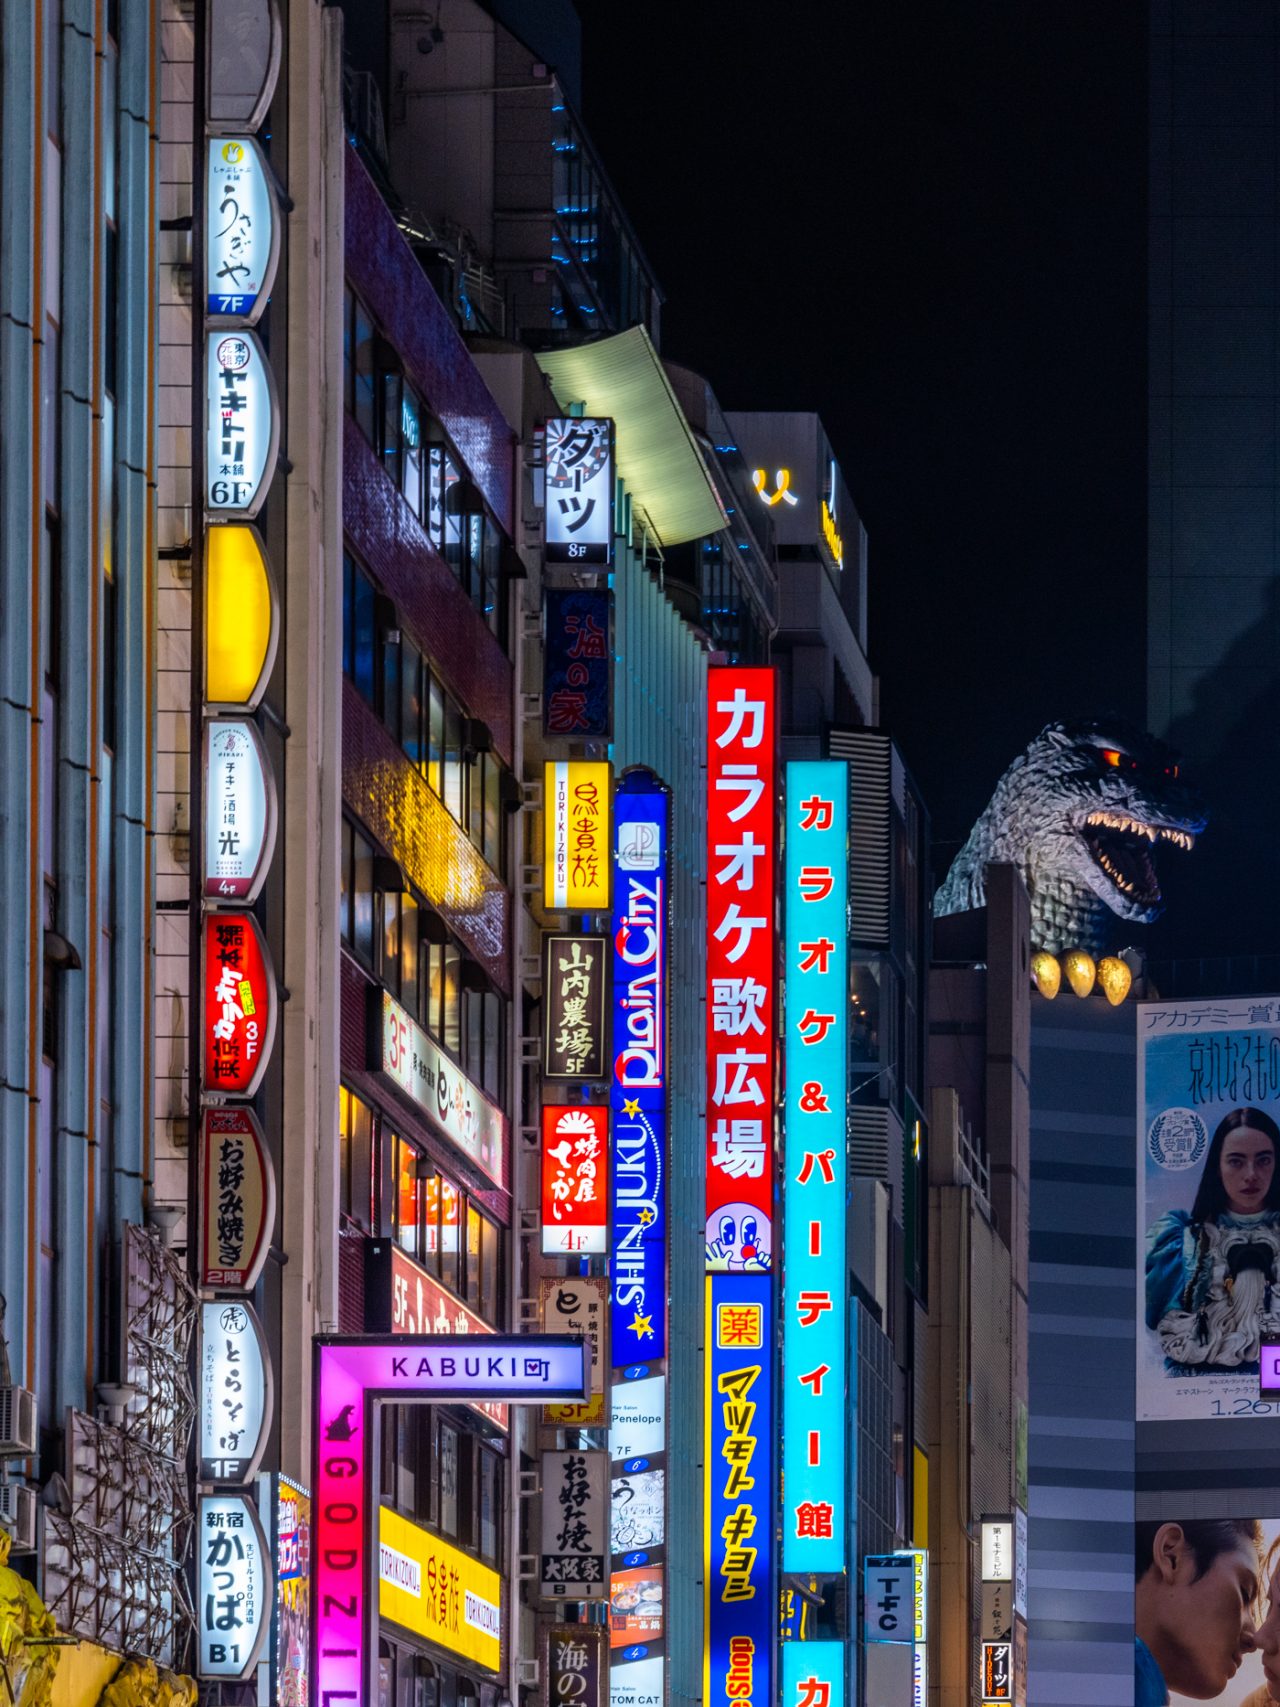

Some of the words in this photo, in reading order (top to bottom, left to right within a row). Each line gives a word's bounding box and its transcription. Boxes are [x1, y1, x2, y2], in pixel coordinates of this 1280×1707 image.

[214, 185, 251, 287] うさぎや
[218, 297, 244, 312] 7F
[219, 464, 244, 476] 本舗
[558, 425, 600, 533] ダーツ
[211, 482, 252, 504] 6F
[568, 543, 586, 558] 8F
[548, 614, 607, 733] 海の家
[224, 762, 236, 826] チキン酒場
[218, 831, 240, 856] 光
[218, 880, 236, 894] 4F
[711, 688, 768, 1180] カラオケ歌広場
[556, 942, 595, 1057] 山内農場
[389, 1013, 407, 1073] 3F
[566, 1058, 585, 1073] 5F
[217, 1138, 245, 1267] お好み焼き
[616, 1124, 658, 1307] SHINJUKU
[561, 1229, 588, 1250] 4F
[207, 1271, 241, 1284] 2階
[394, 1274, 408, 1328] 5F
[722, 1308, 758, 1344] 薬
[219, 1339, 245, 1451] とらそば
[612, 1414, 662, 1425] Penelope
[616, 1446, 632, 1455] 7F
[211, 1460, 240, 1478] 1F
[556, 1455, 593, 1552] お好み焼
[206, 1511, 244, 1528] 新宿
[206, 1530, 245, 1631] かっぱ
[545, 1557, 601, 1581] 大阪家
[209, 1643, 240, 1663] B1
[726, 1636, 754, 1699] Shop
[994, 1646, 1008, 1687] ダーツ
[611, 1696, 635, 1704] TOM
[638, 1696, 660, 1704] CAT
